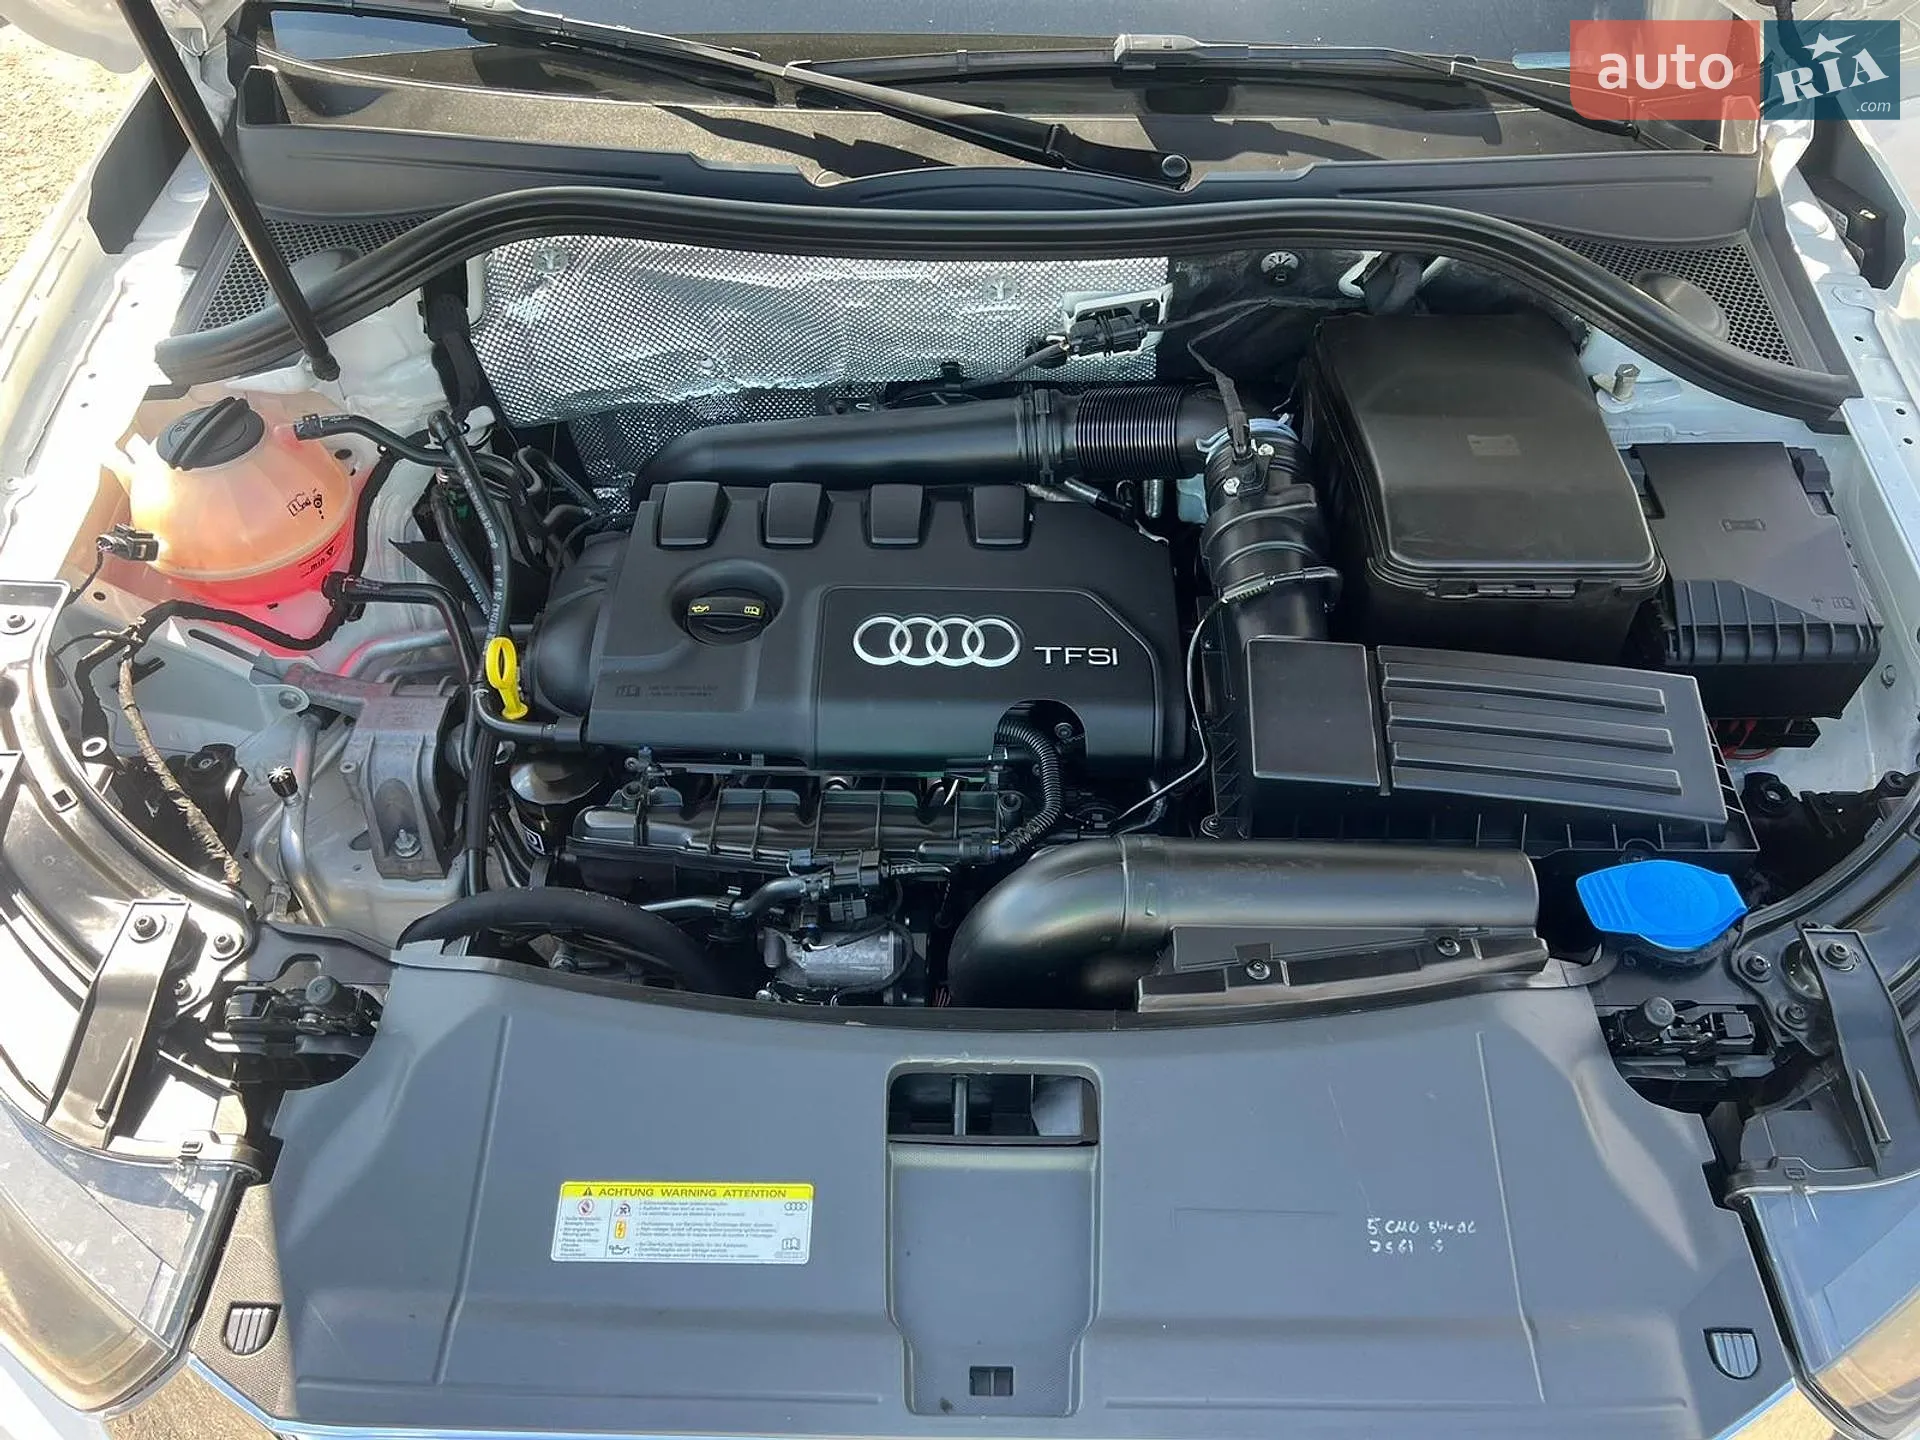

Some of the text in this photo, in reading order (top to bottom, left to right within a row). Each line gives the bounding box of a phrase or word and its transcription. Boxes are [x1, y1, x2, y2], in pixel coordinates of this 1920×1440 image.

[1034, 646, 1118, 666] TFSI
[598, 1187, 787, 1199] ACHTUNG WARNING ATTENTION
